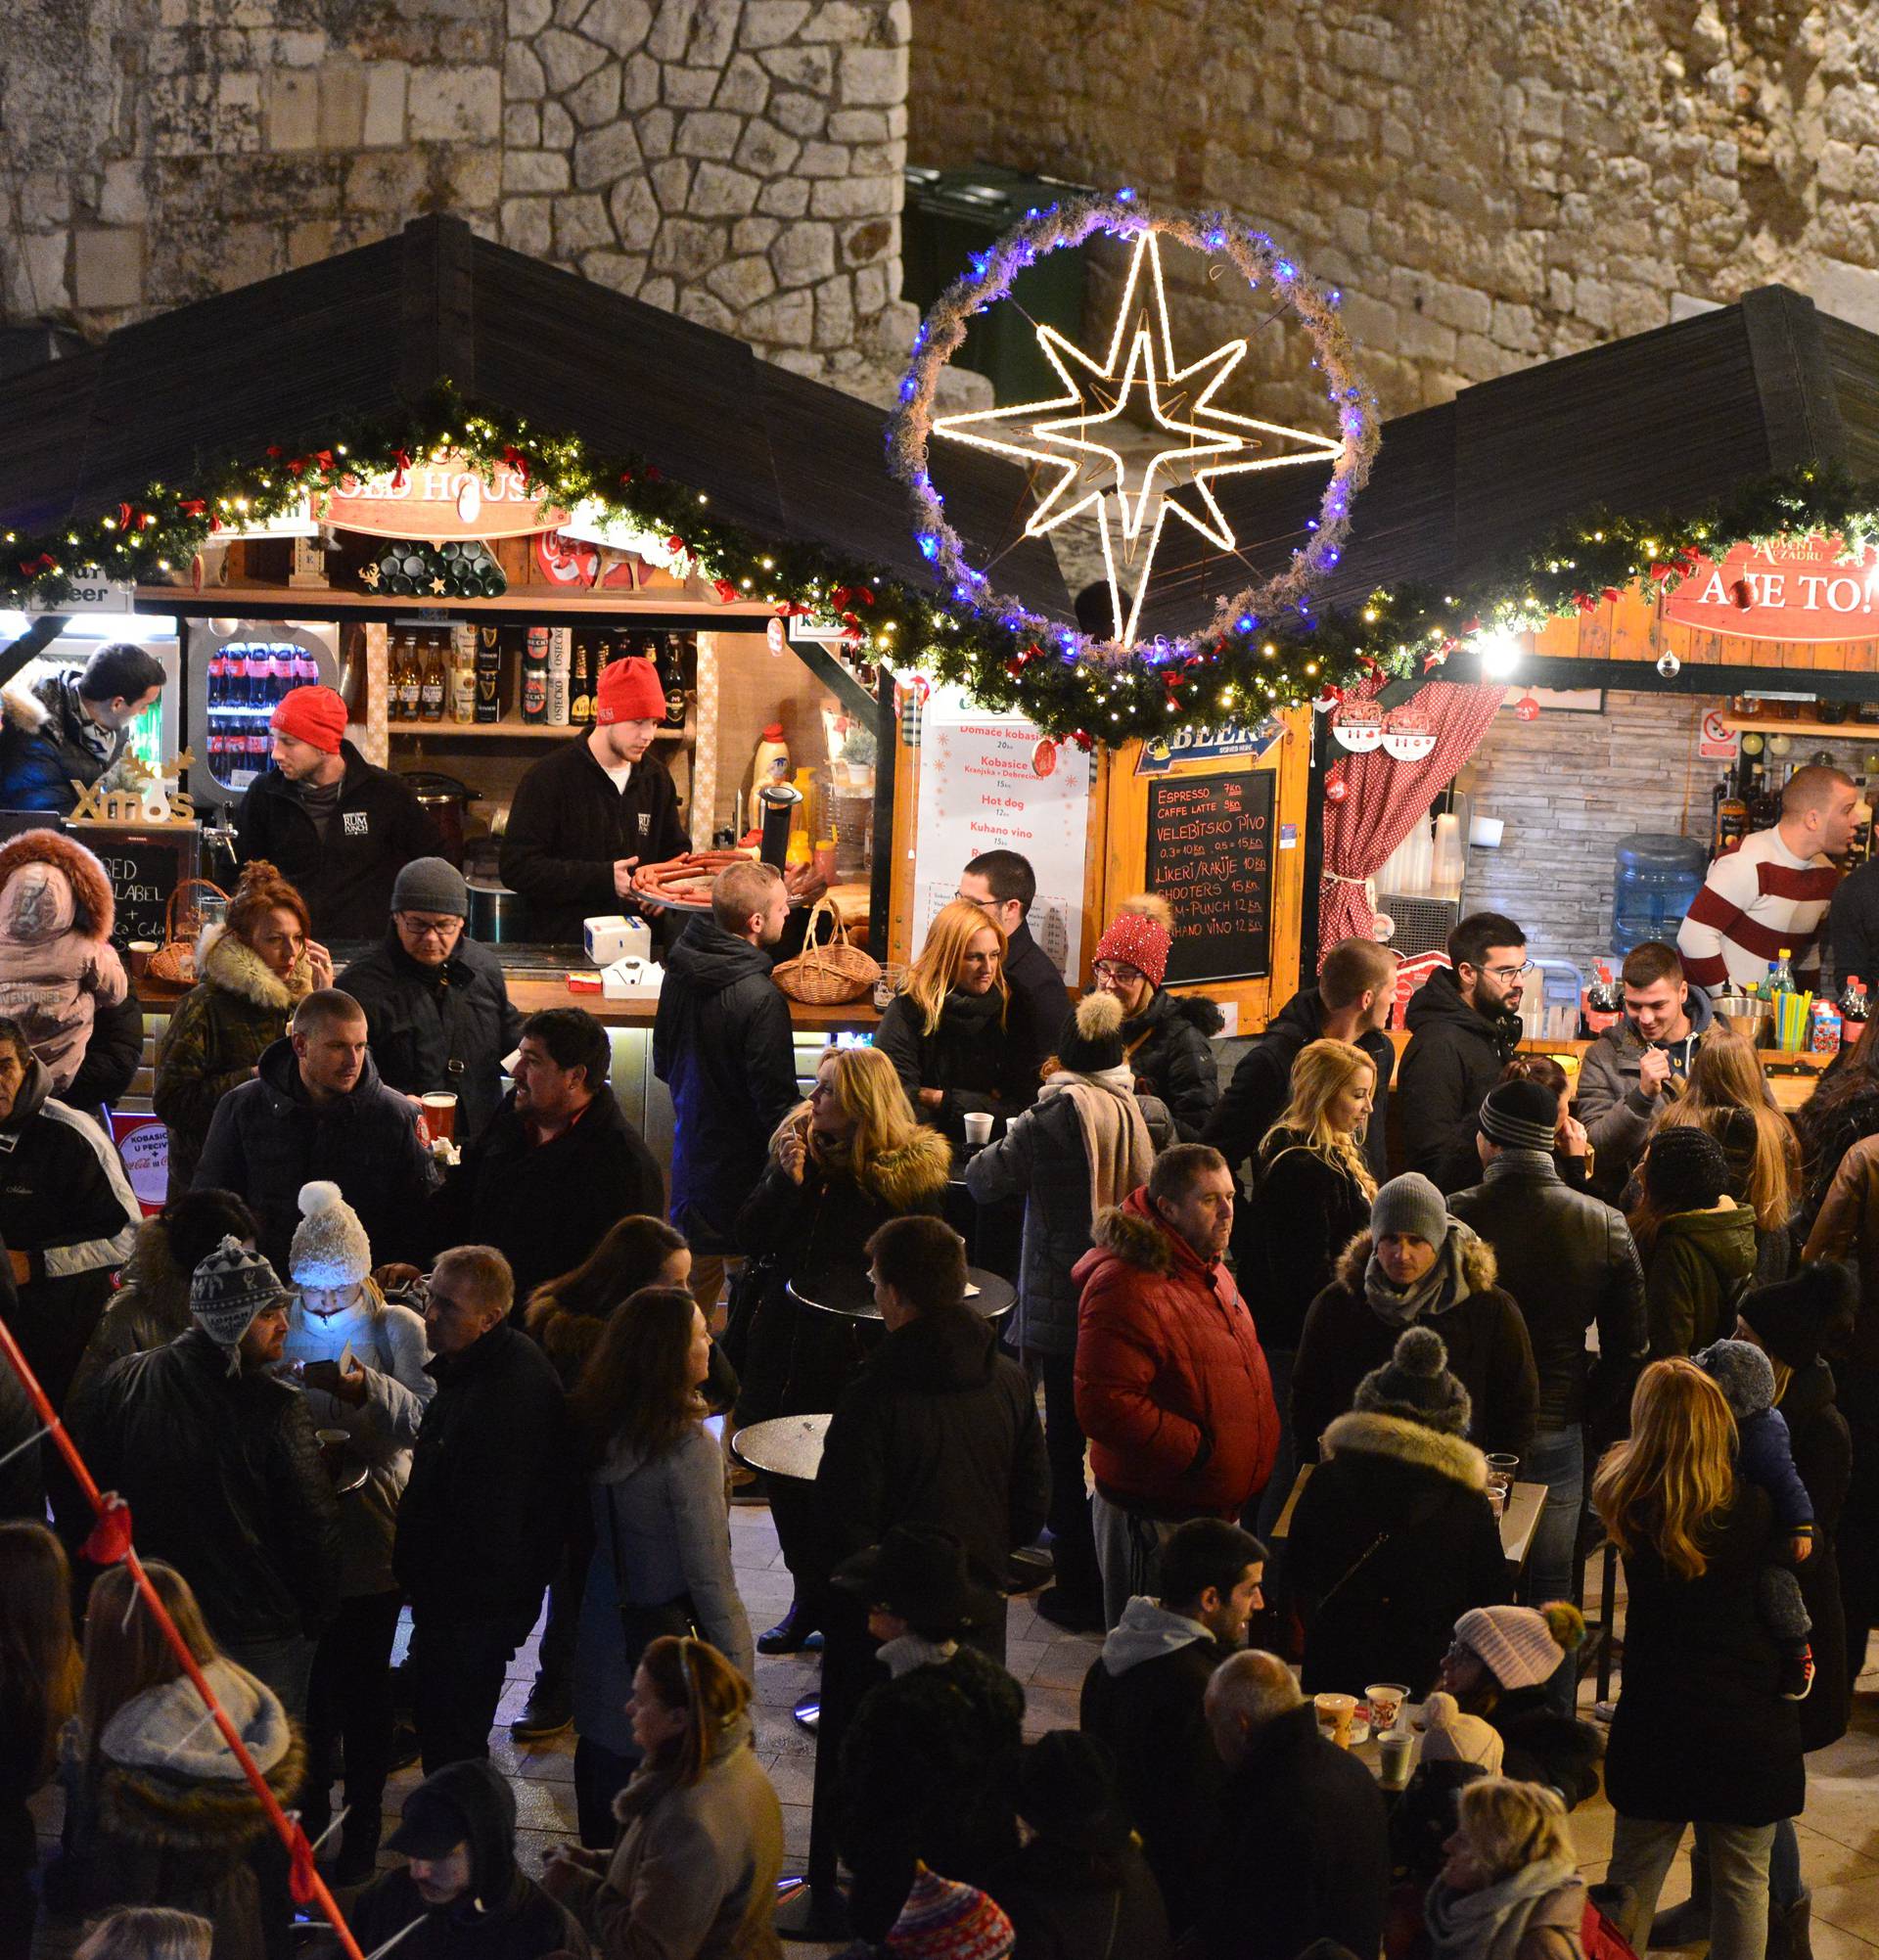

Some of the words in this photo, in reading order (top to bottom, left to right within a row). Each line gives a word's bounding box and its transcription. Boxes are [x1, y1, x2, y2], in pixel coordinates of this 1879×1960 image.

[1780, 550, 1823, 562] ZADRU
[69, 587, 109, 602] eer
[1798, 574, 1872, 614] TO!
[1170, 723, 1259, 750] BEER
[981, 756, 1029, 770] Kobasice
[982, 795, 1002, 807] Hot
[1004, 797, 1025, 811] dog
[1158, 788, 1211, 804] ESPRESSO
[1157, 806, 1188, 819] CAFFE
[1191, 802, 1217, 814] LATTE
[344, 815, 367, 826] RUM
[970, 821, 1009, 836] Kuhano
[1011, 827, 1033, 840] vino
[102, 857, 137, 880] RED
[115, 884, 164, 902] LABEL
[1158, 882, 1222, 900] SHOOTERS
[1174, 900, 1230, 918] M-PUNCH
[1170, 923, 1203, 938] HANO
[130, 1132, 168, 1144] KOBASIC
[142, 1142, 167, 1152] PECIV
